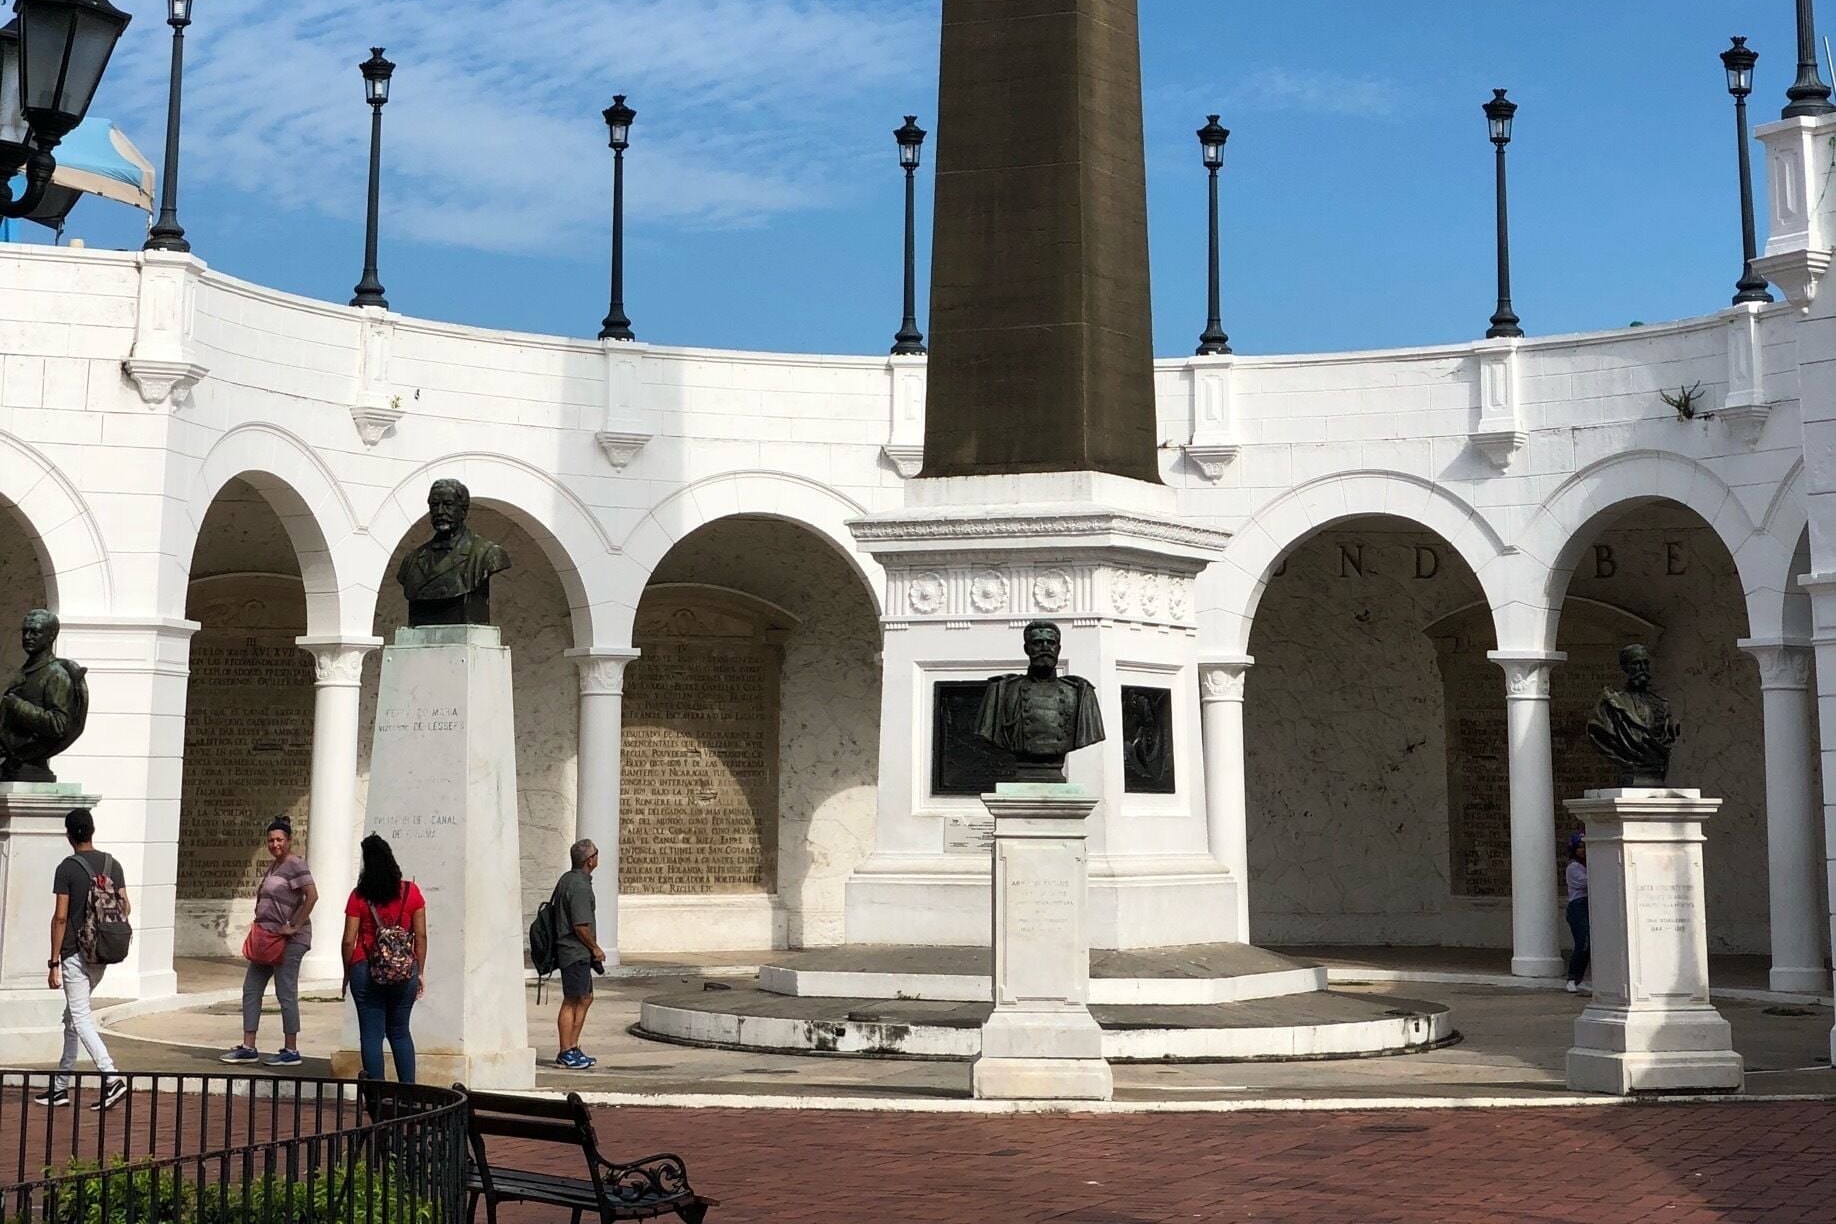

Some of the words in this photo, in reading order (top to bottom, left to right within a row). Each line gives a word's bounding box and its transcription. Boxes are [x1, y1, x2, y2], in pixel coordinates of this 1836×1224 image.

[622, 740, 680, 749] ASCENDENTALES
[621, 769, 659, 777] UANTEPEC
[619, 778, 657, 787] CONGRESO
[431, 815, 458, 825] CANAL
